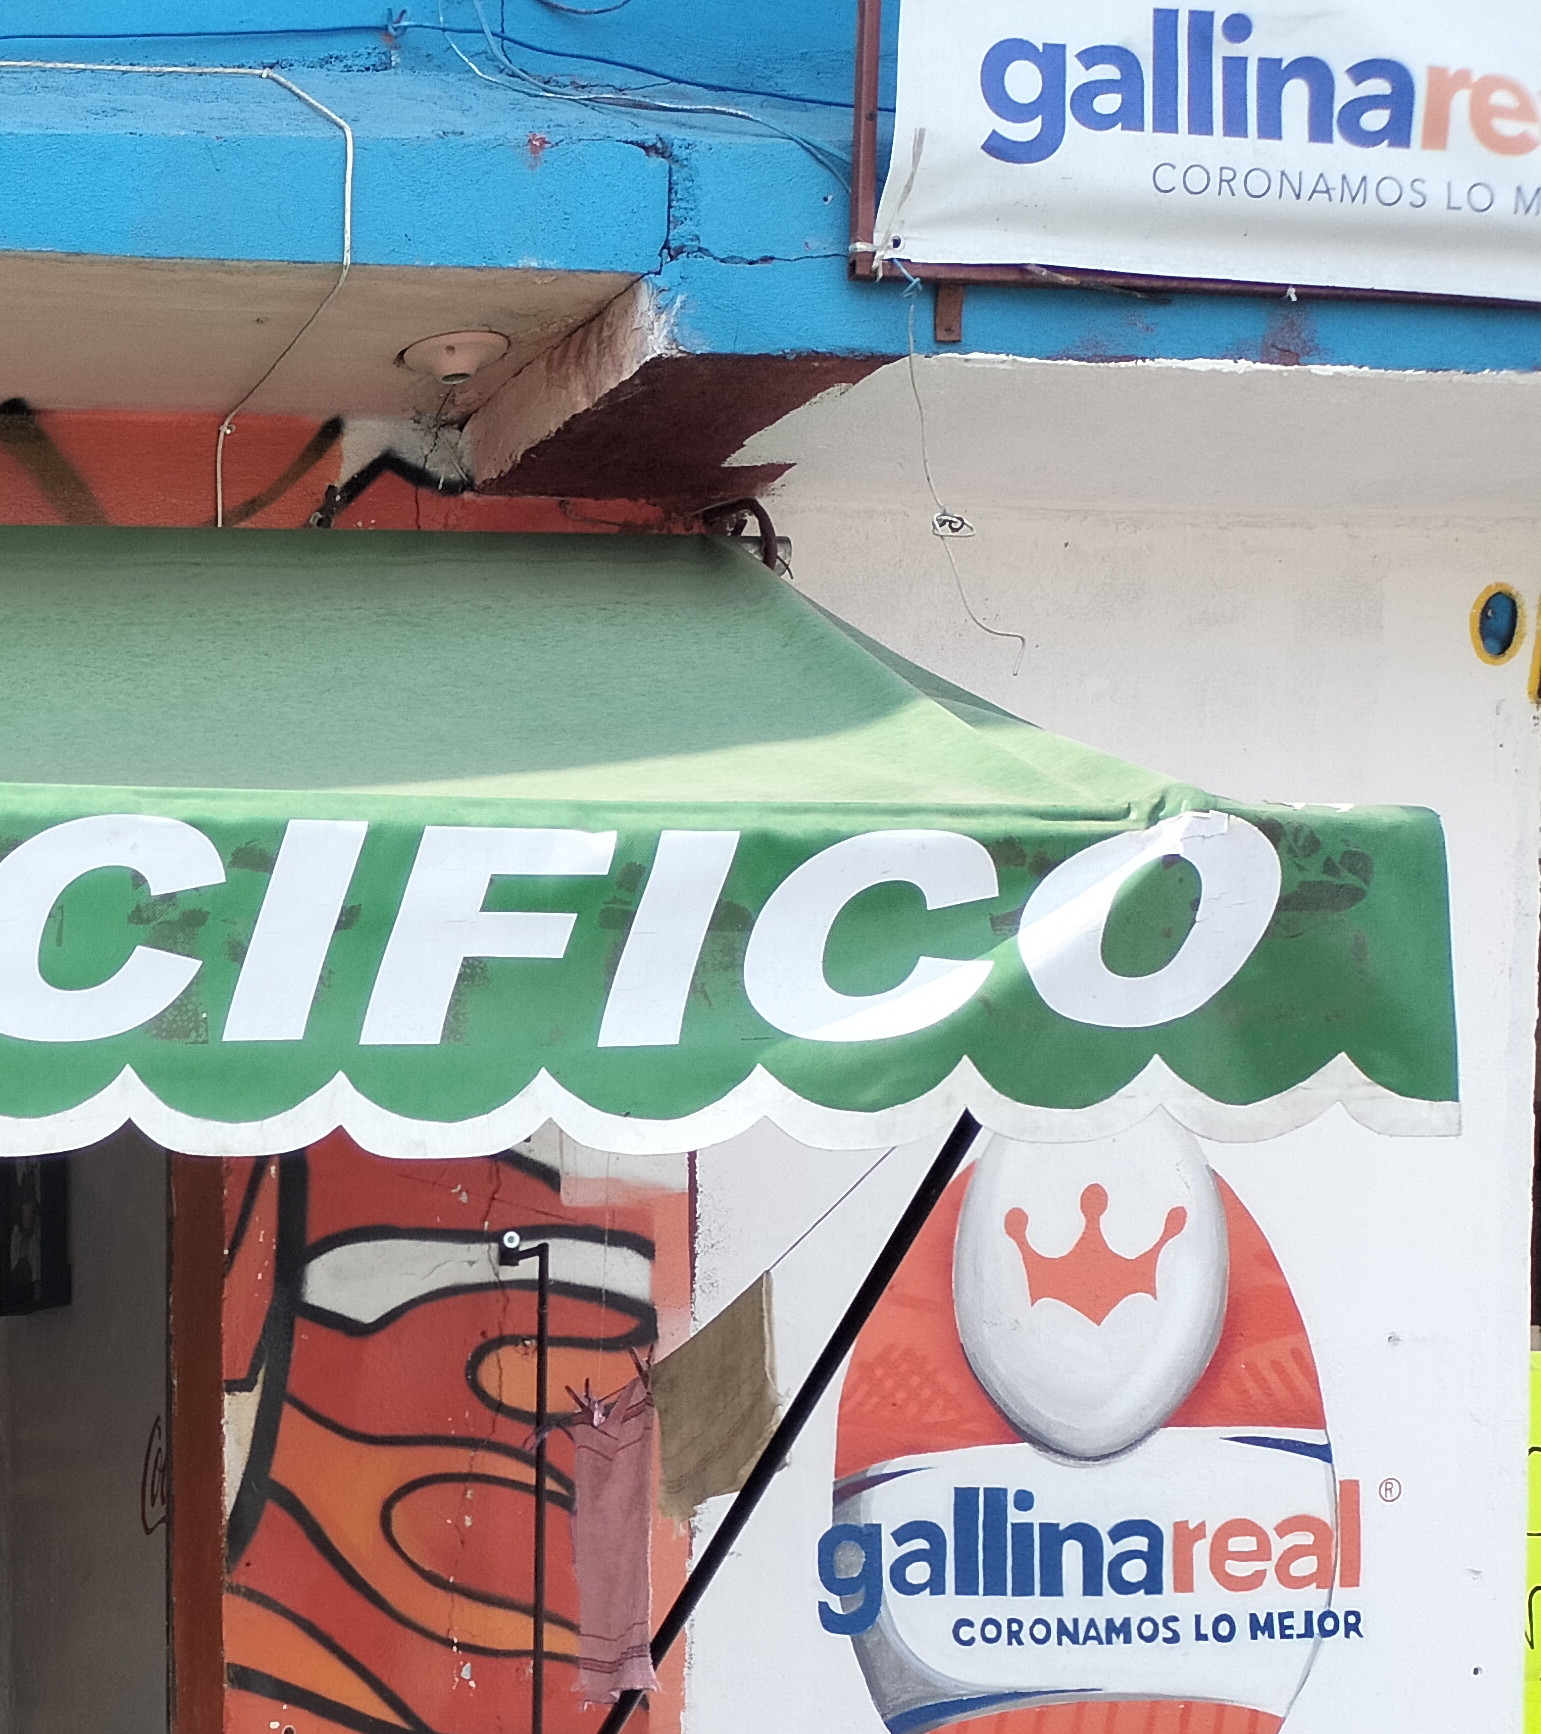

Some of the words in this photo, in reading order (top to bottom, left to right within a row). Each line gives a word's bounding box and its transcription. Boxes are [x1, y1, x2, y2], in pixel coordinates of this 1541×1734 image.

[980, 7, 1541, 164] gallinare
[1152, 162, 1427, 209] CORONAMOS
[1445, 181, 1495, 213] LO
[816, 1478, 1361, 1636] gallinareal
[951, 1614, 1181, 1647] CORONAMOS
[1194, 1613, 1237, 1644] LO
[1248, 1609, 1365, 1640] MEJOR
